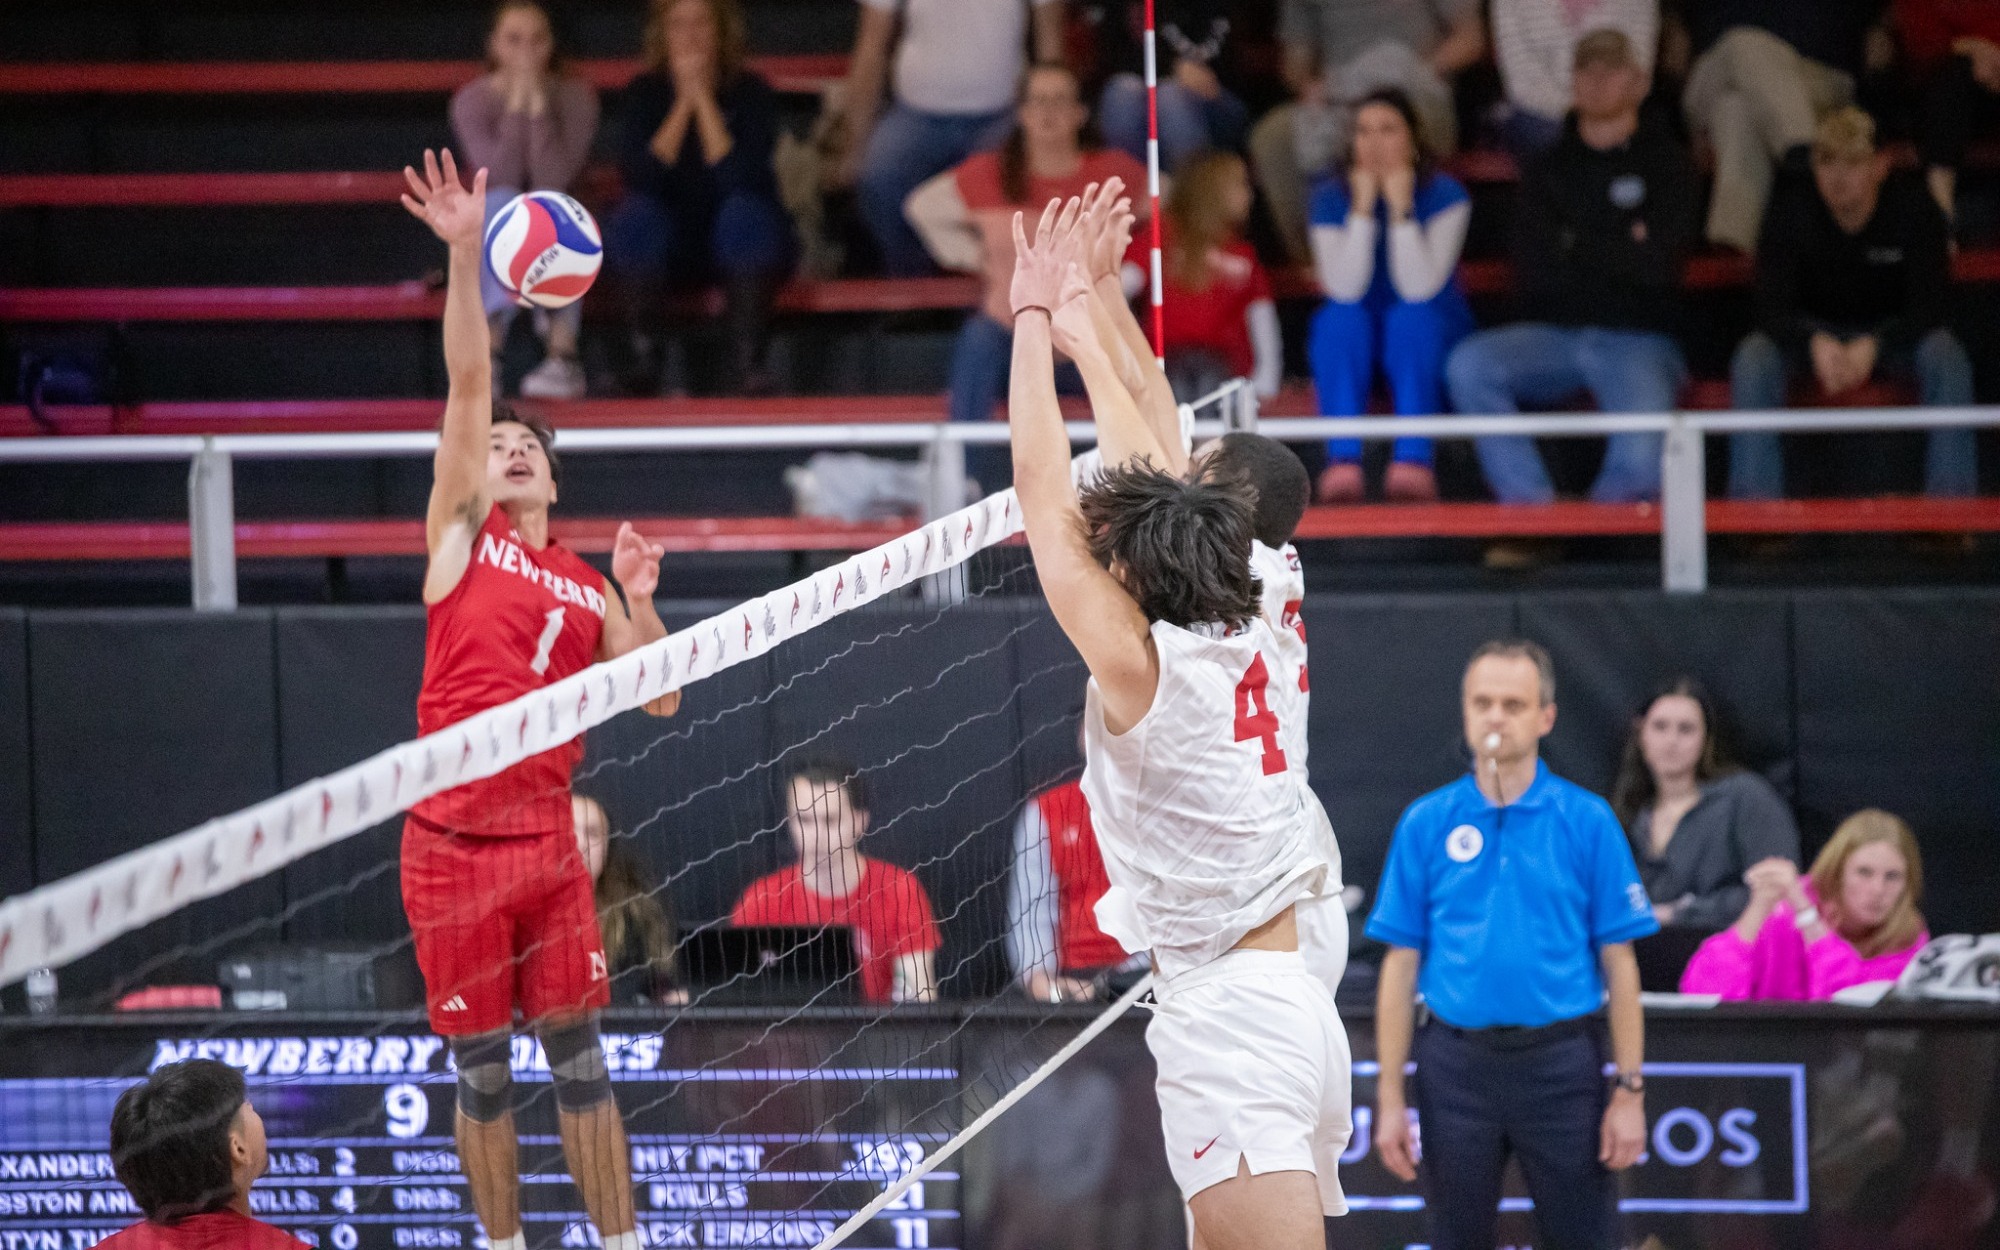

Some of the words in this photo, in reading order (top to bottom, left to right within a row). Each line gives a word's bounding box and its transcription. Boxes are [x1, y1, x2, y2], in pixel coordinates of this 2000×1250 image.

[530, 605, 566, 676] 1
[1234, 650, 1288, 777] 4
[148, 1035, 443, 1075] NEWBERRY
[384, 1084, 429, 1139] 9
[1637, 1106, 1761, 1167] OS
[333, 1147, 357, 1177] 2
[632, 1145, 691, 1172] HIT
[696, 1145, 765, 1172] PCT
[331, 1186, 357, 1214] 4
[650, 1182, 748, 1209] KILLS
[0, 1229, 62, 1250] TYN
[331, 1223, 358, 1250] 0
[703, 1221, 836, 1249] ERRORS
[891, 1217, 929, 1249] 11
